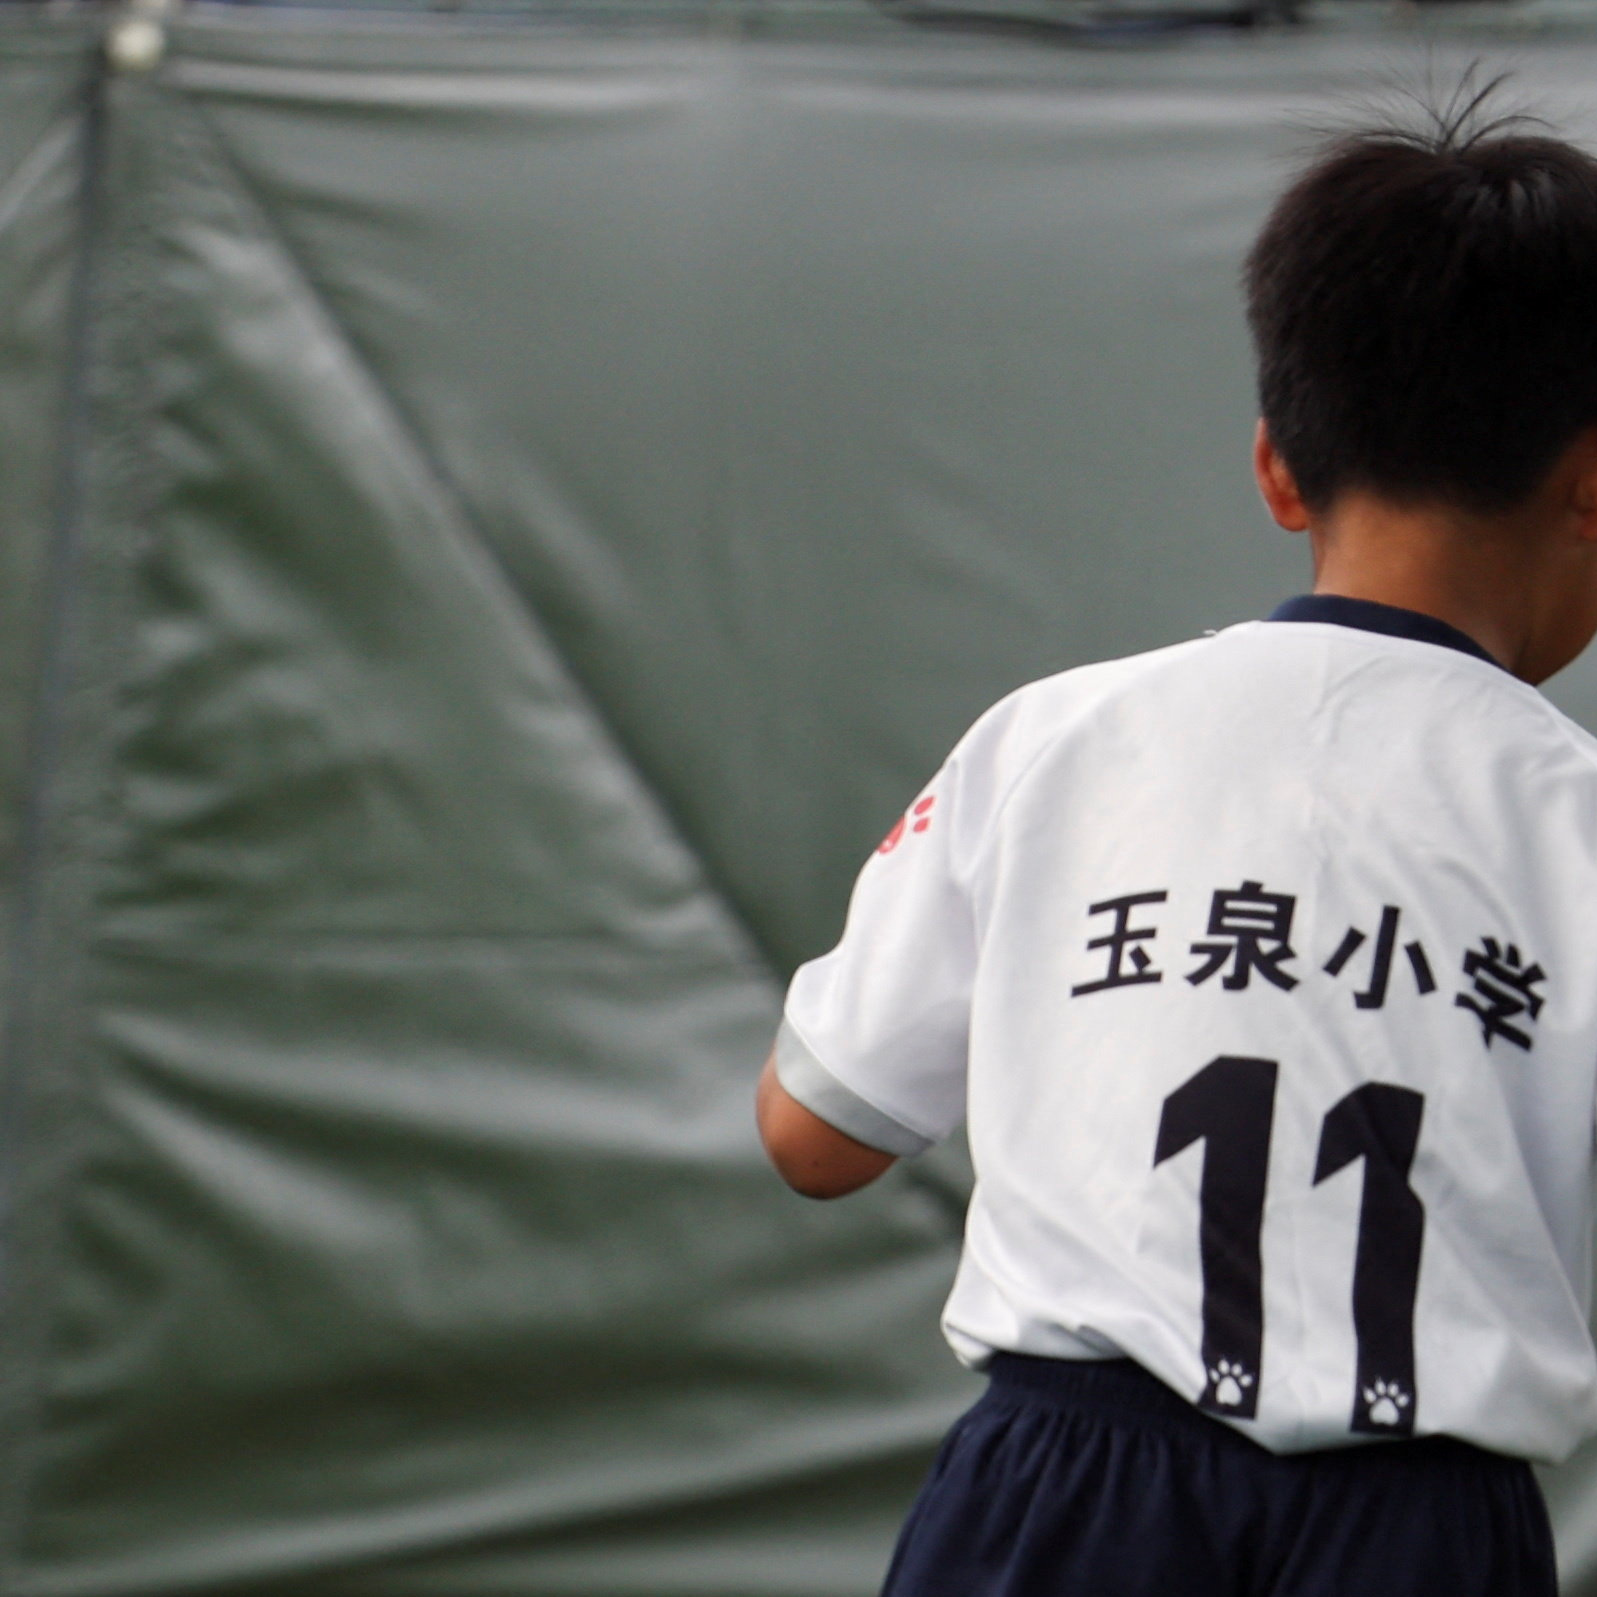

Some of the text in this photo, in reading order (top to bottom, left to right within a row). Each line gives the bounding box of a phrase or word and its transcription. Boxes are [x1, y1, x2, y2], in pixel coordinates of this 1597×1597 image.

[1071, 880, 1547, 1051] 玉泉小学
[1153, 1055, 1425, 1435] 11
